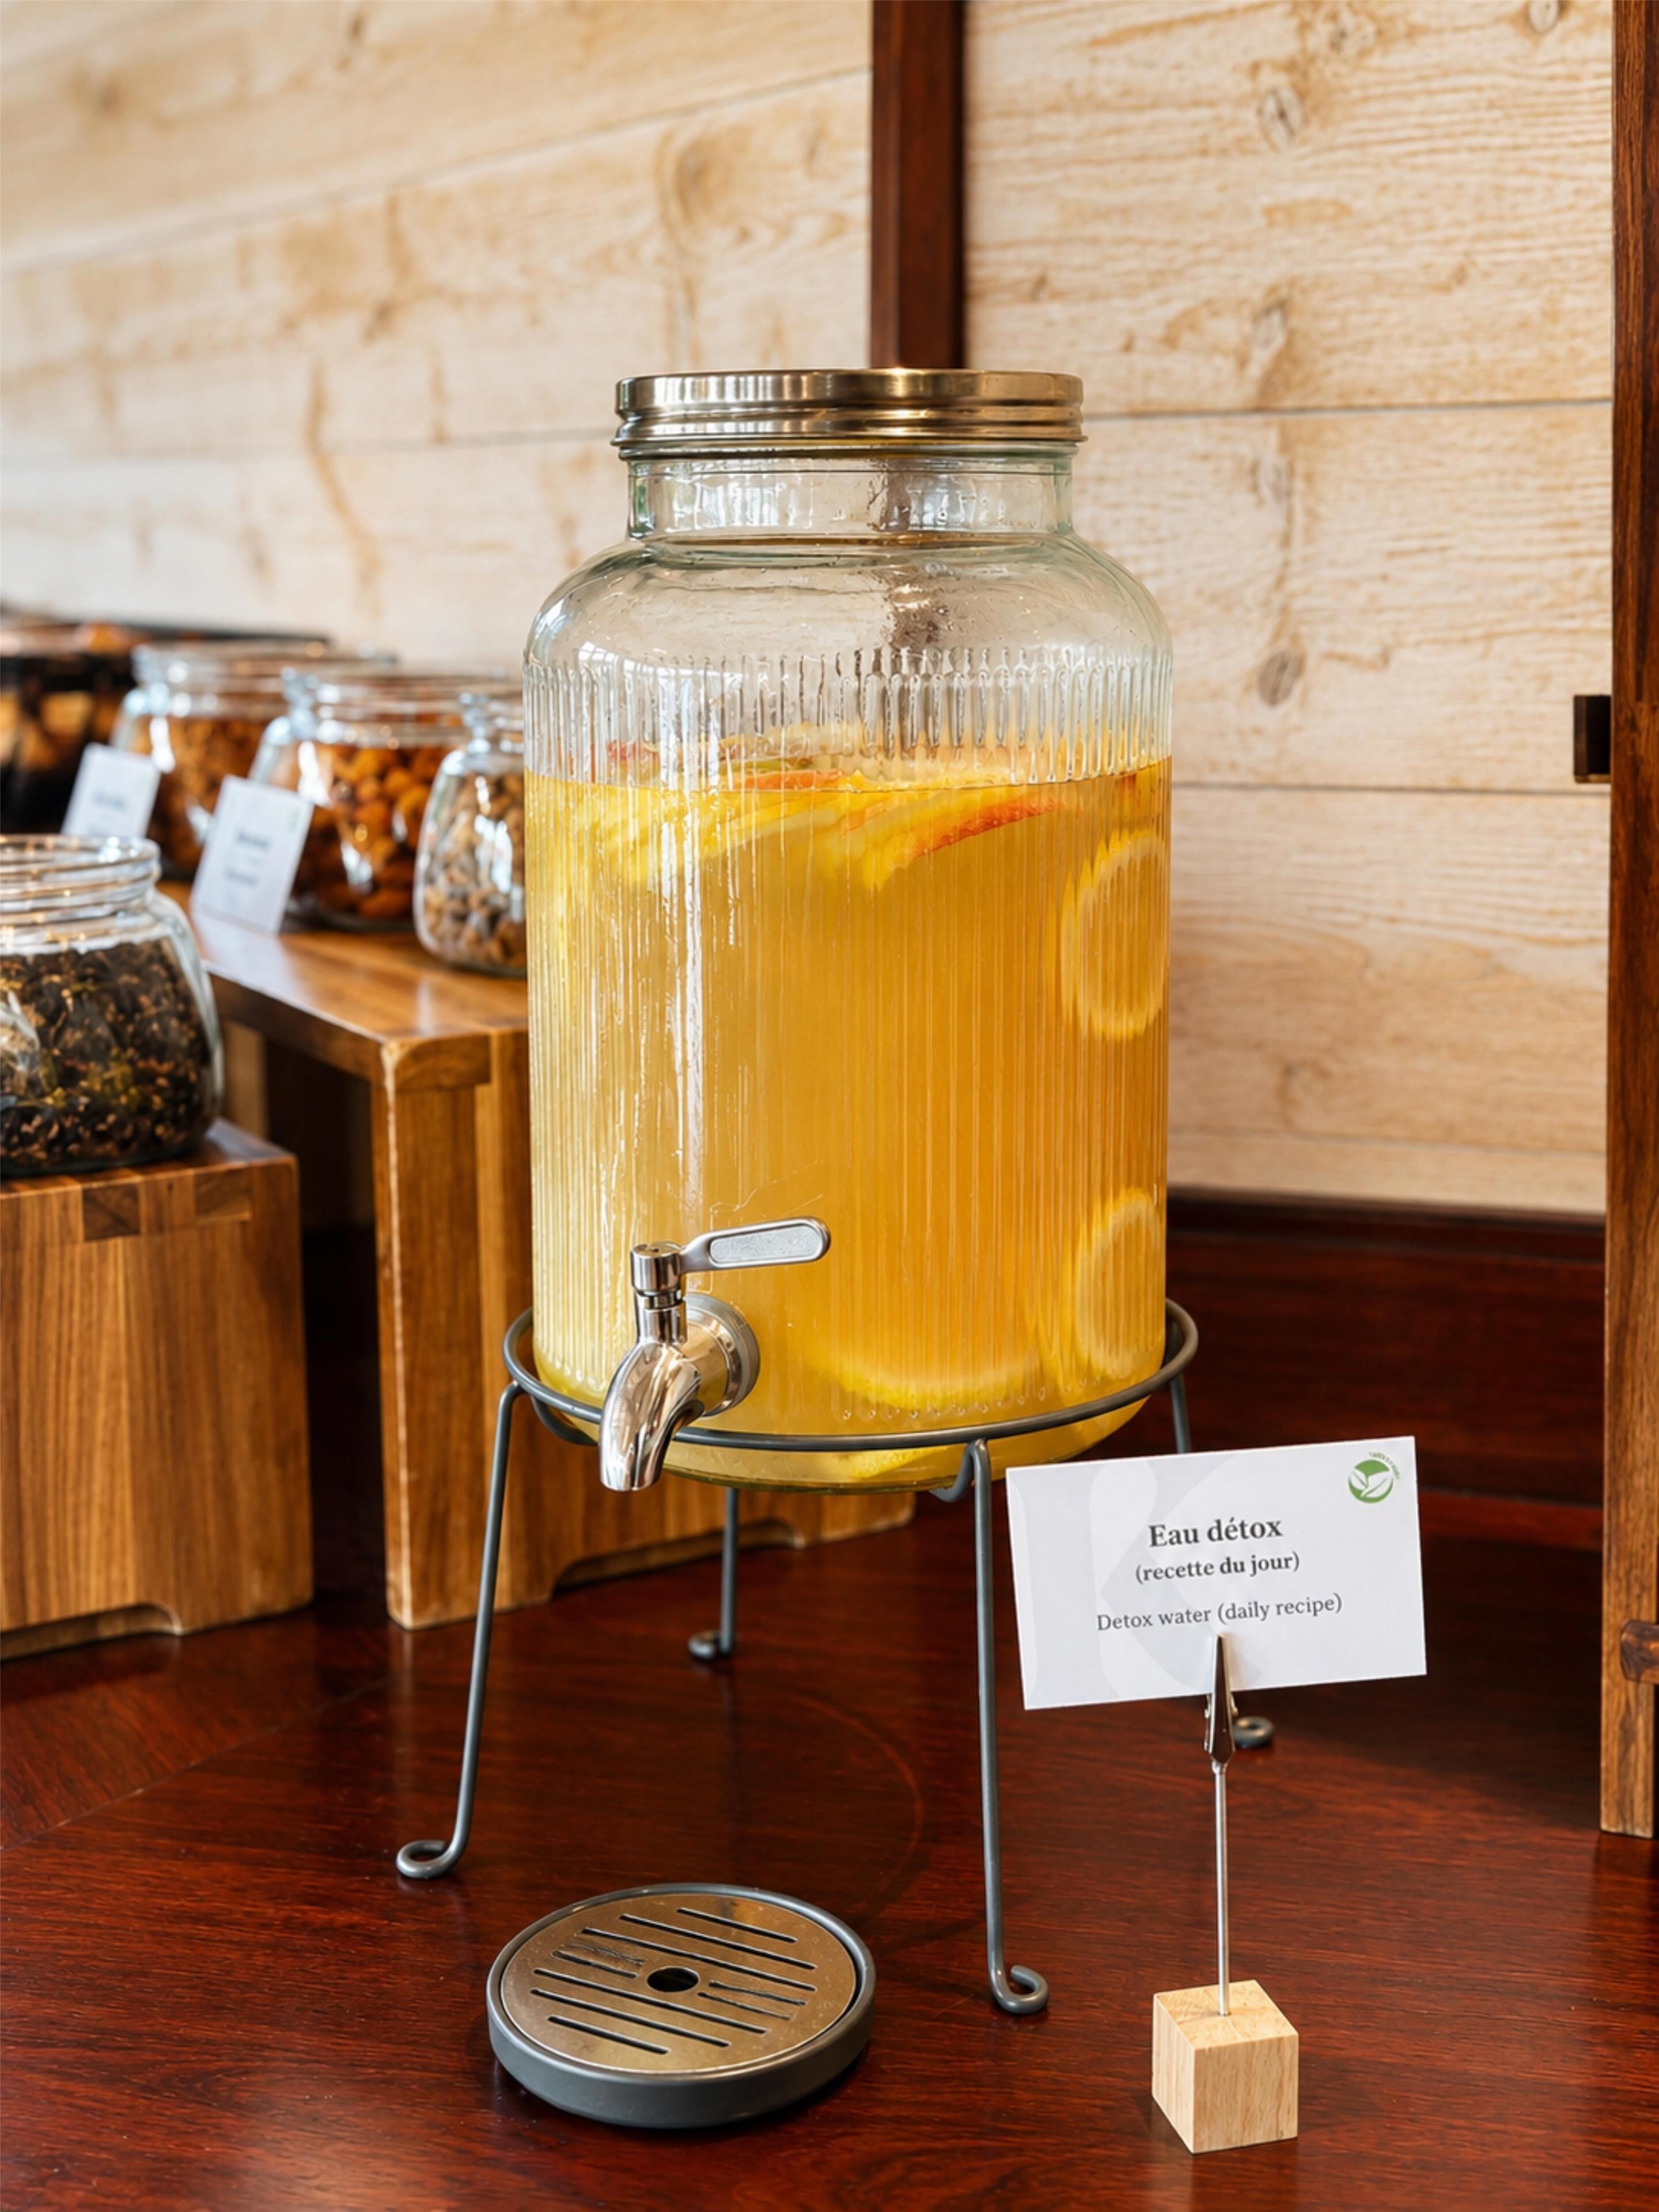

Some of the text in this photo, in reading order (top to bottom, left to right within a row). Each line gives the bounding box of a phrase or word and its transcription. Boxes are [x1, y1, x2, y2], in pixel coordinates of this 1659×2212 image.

[1148, 1516, 1283, 1548] Eau détox
[1135, 1551, 1300, 1585] (recette du jour)
[1097, 1592, 1342, 1631] Detox water (daily recipe)
